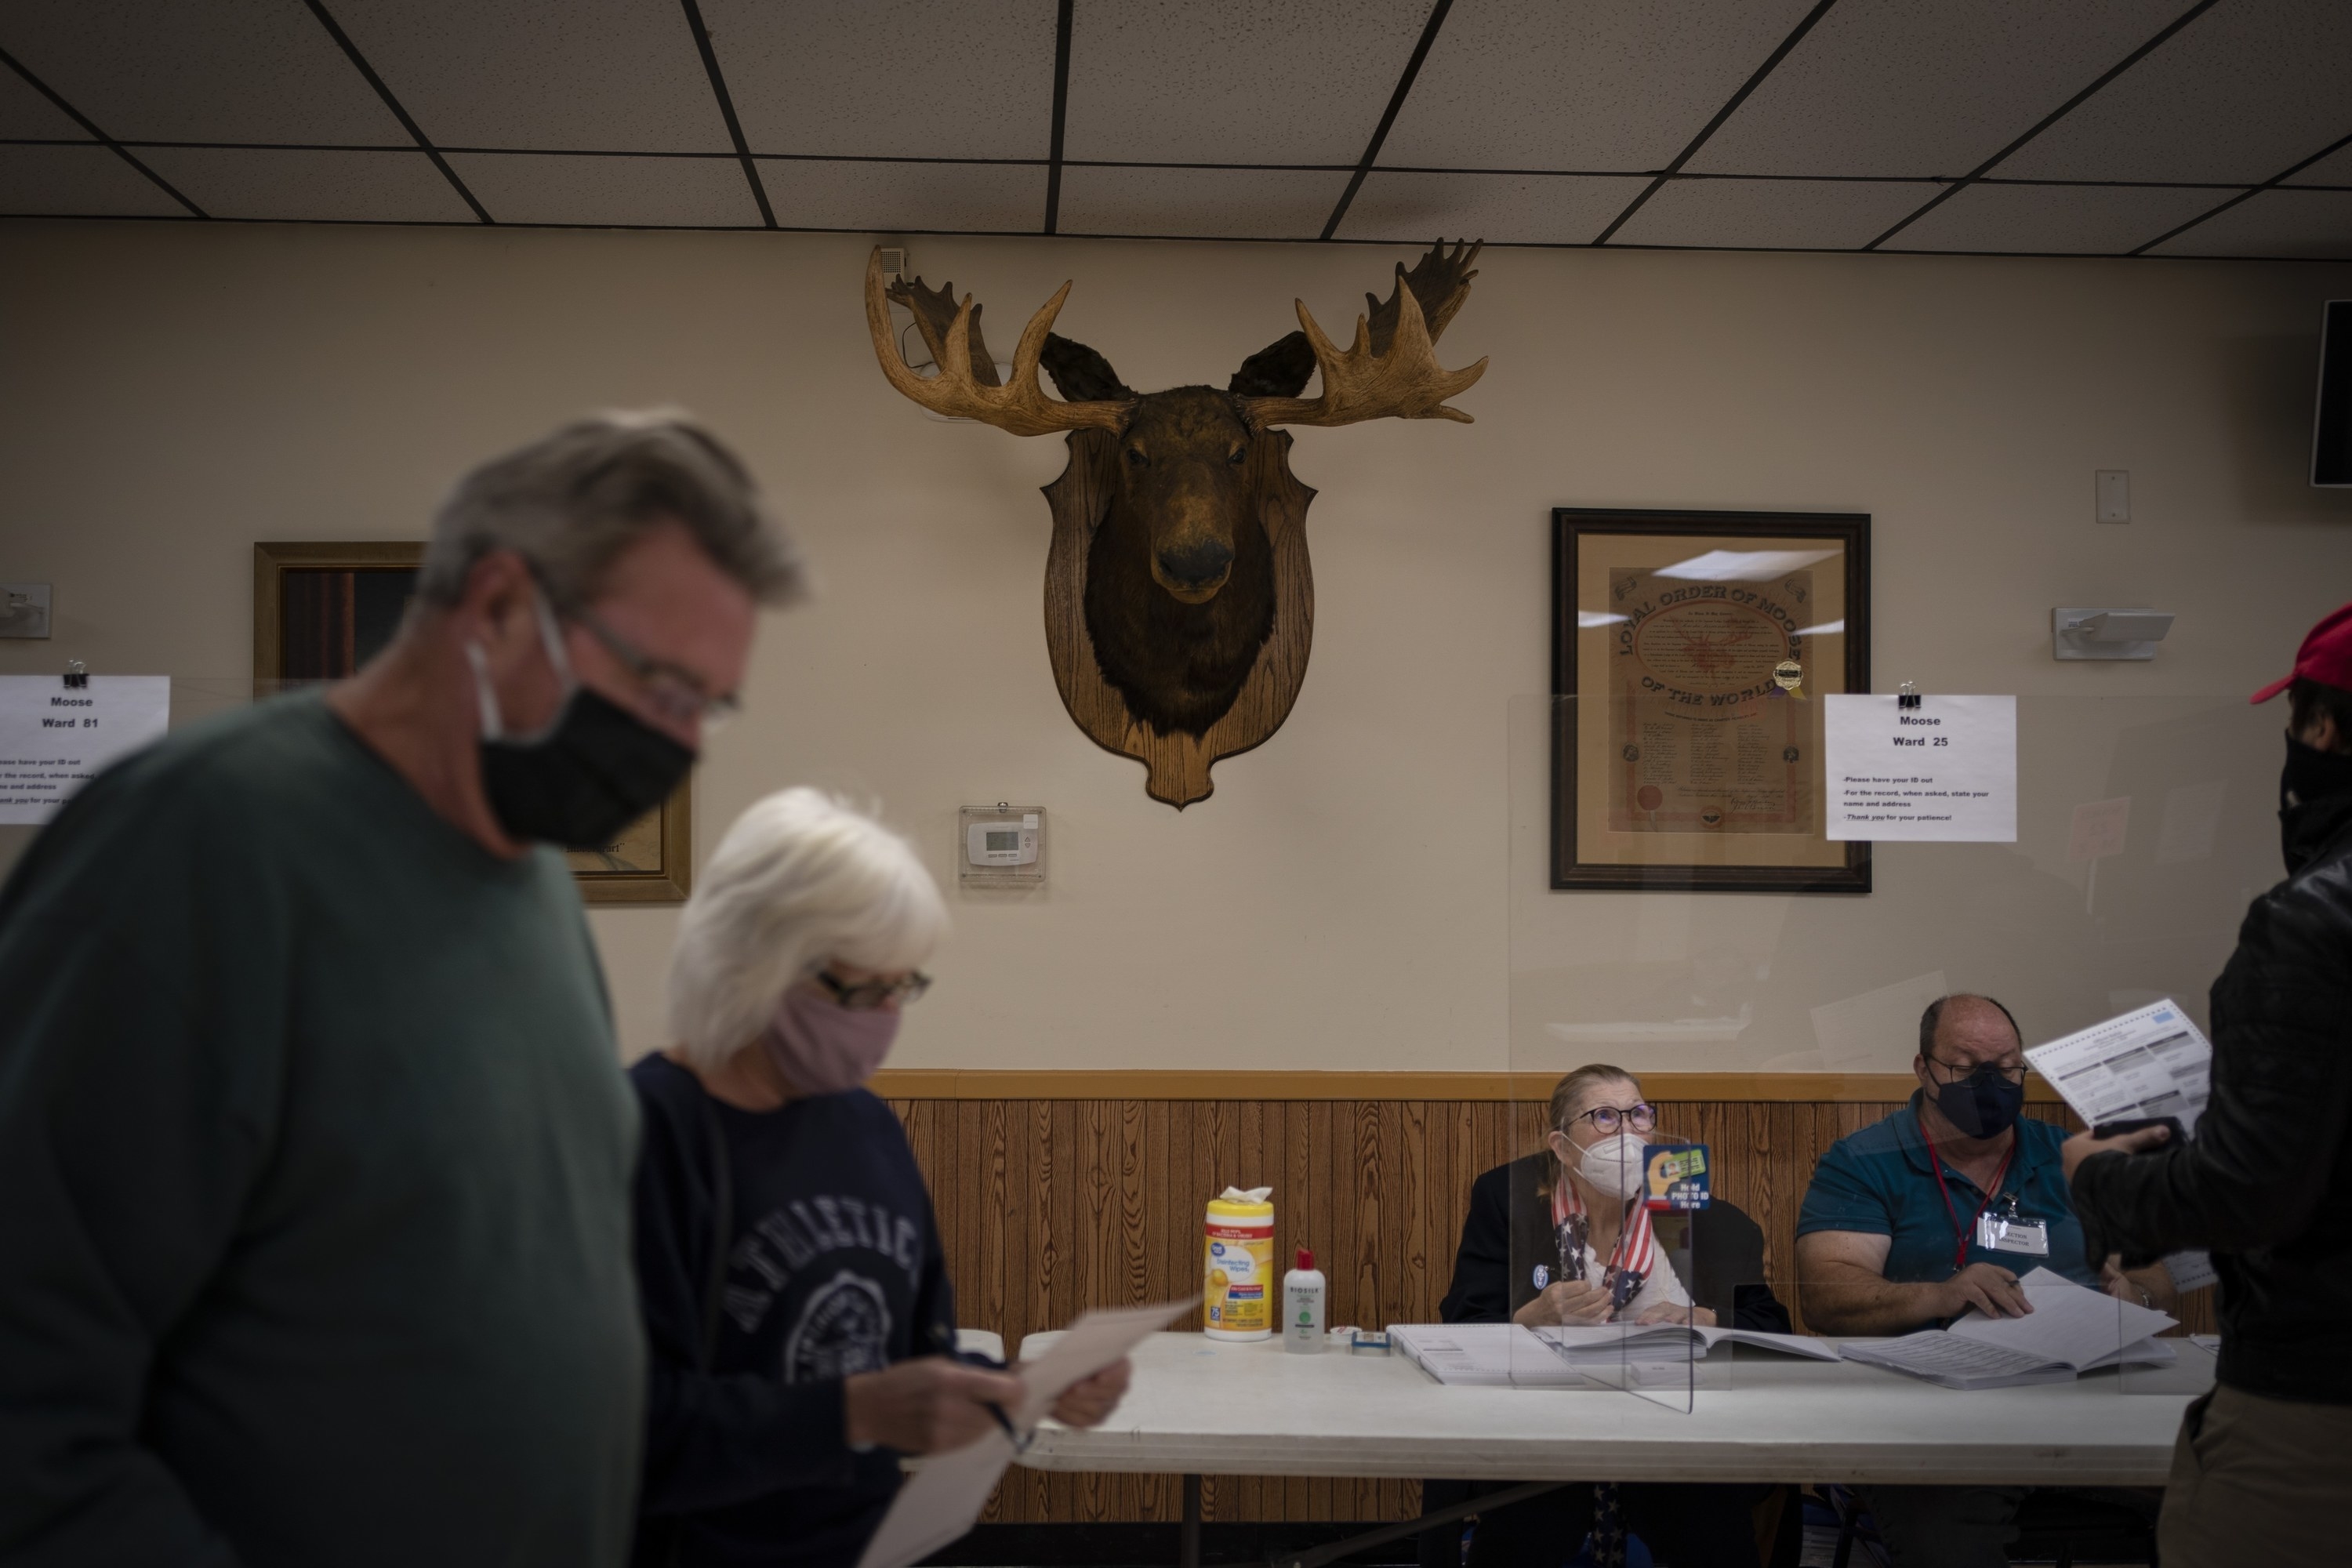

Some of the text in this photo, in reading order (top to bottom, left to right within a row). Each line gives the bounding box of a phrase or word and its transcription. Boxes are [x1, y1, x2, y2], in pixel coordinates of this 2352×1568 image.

[1619, 585, 1802, 660] LOYAL ORDER OF MOOSE
[1641, 676, 1777, 706] OF THE WORLD
[50, 697, 93, 706] Moose
[42, 718, 98, 728] Ward 81
[1900, 717, 1941, 726] Moose
[1893, 737, 1949, 746] Ward 25
[1680, 1182, 1700, 1192] Hold
[1700, 1191, 1709, 1200] ID
[1680, 1200, 1701, 1209] Here
[1217, 1258, 1250, 1268] Disinfecting
[1211, 1308, 1220, 1317] 75
